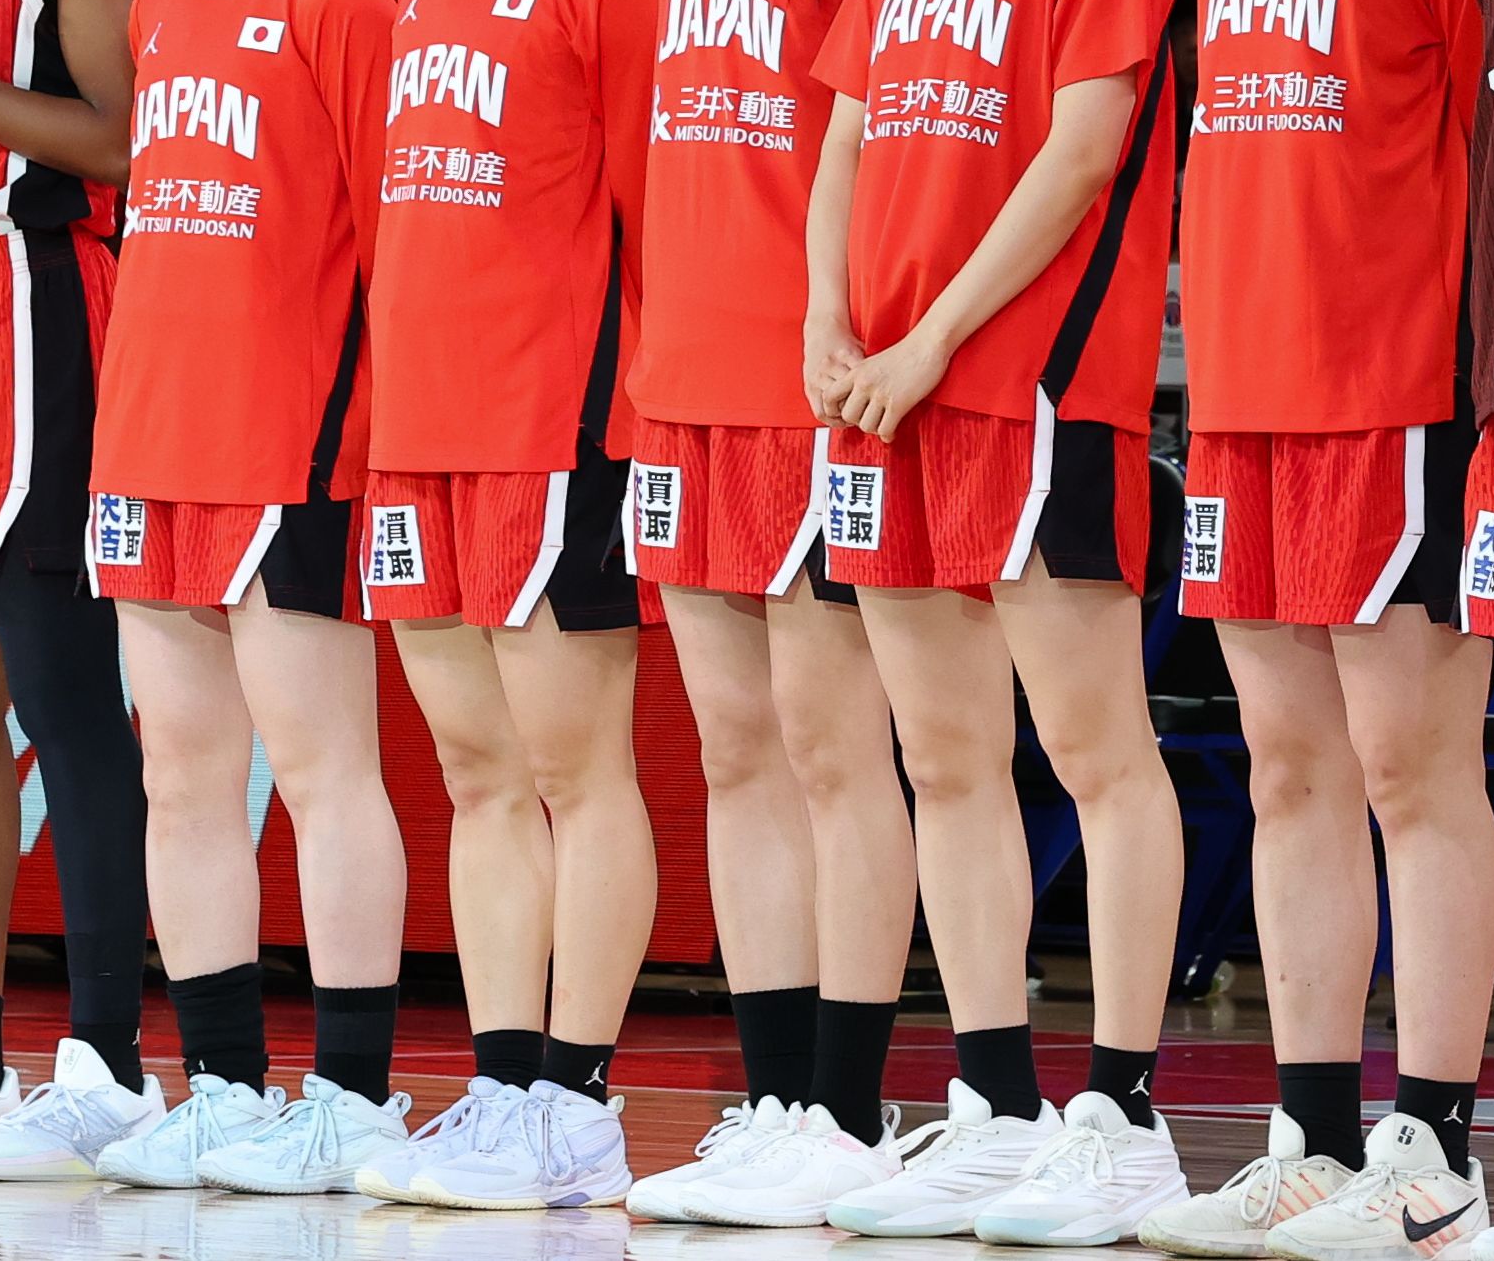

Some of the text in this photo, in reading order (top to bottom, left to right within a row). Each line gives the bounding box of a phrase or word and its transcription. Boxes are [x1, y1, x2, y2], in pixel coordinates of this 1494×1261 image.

[386, 43, 508, 128] JAPAN
[877, 78, 1008, 126] 三井不動産
[1212, 71, 1348, 111] 三井不動産
[131, 75, 261, 161] JAPAN
[674, 125, 720, 143] MITSUI
[875, 116, 999, 148] MITS FUDOSAN
[1212, 113, 1264, 132] MITSUI
[393, 145, 506, 186] 三井不動産
[141, 178, 261, 218] 三井不動産
[419, 184, 502, 209] FUDOSAN
[174, 218, 254, 240] FUDOSAN
[100, 493, 121, 561] 大吉
[645, 470, 674, 542] 買取
[846, 470, 876, 544] 買取
[386, 511, 414, 580] 買取
[1195, 503, 1219, 576] 買取
